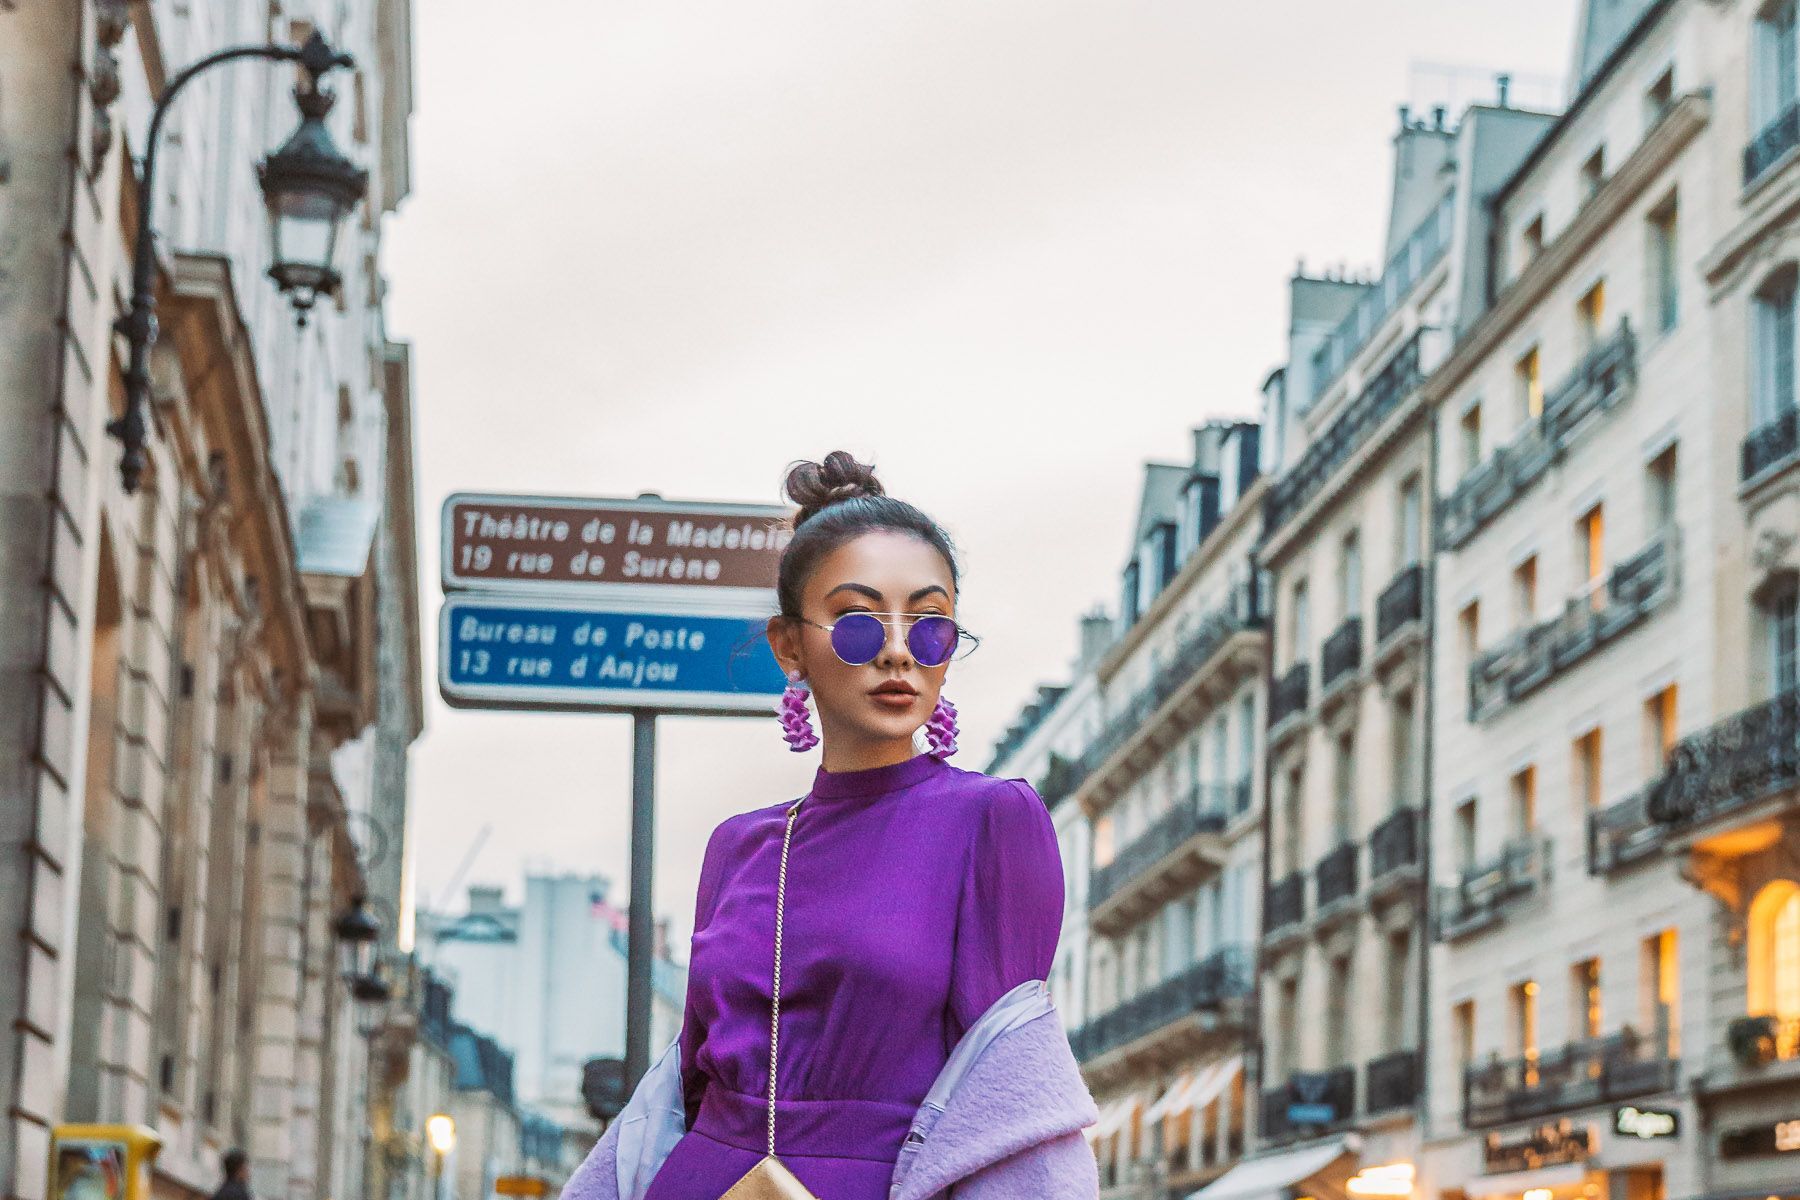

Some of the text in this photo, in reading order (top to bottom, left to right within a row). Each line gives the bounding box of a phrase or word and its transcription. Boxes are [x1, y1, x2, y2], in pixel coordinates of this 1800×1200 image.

[463, 511, 570, 542] Théâtre
[581, 517, 616, 544] de
[627, 519, 654, 546] la
[462, 544, 720, 580] 19 rue de Surène
[459, 615, 706, 651] Bureau de Poste
[460, 649, 491, 676] 13
[507, 657, 553, 678] rue
